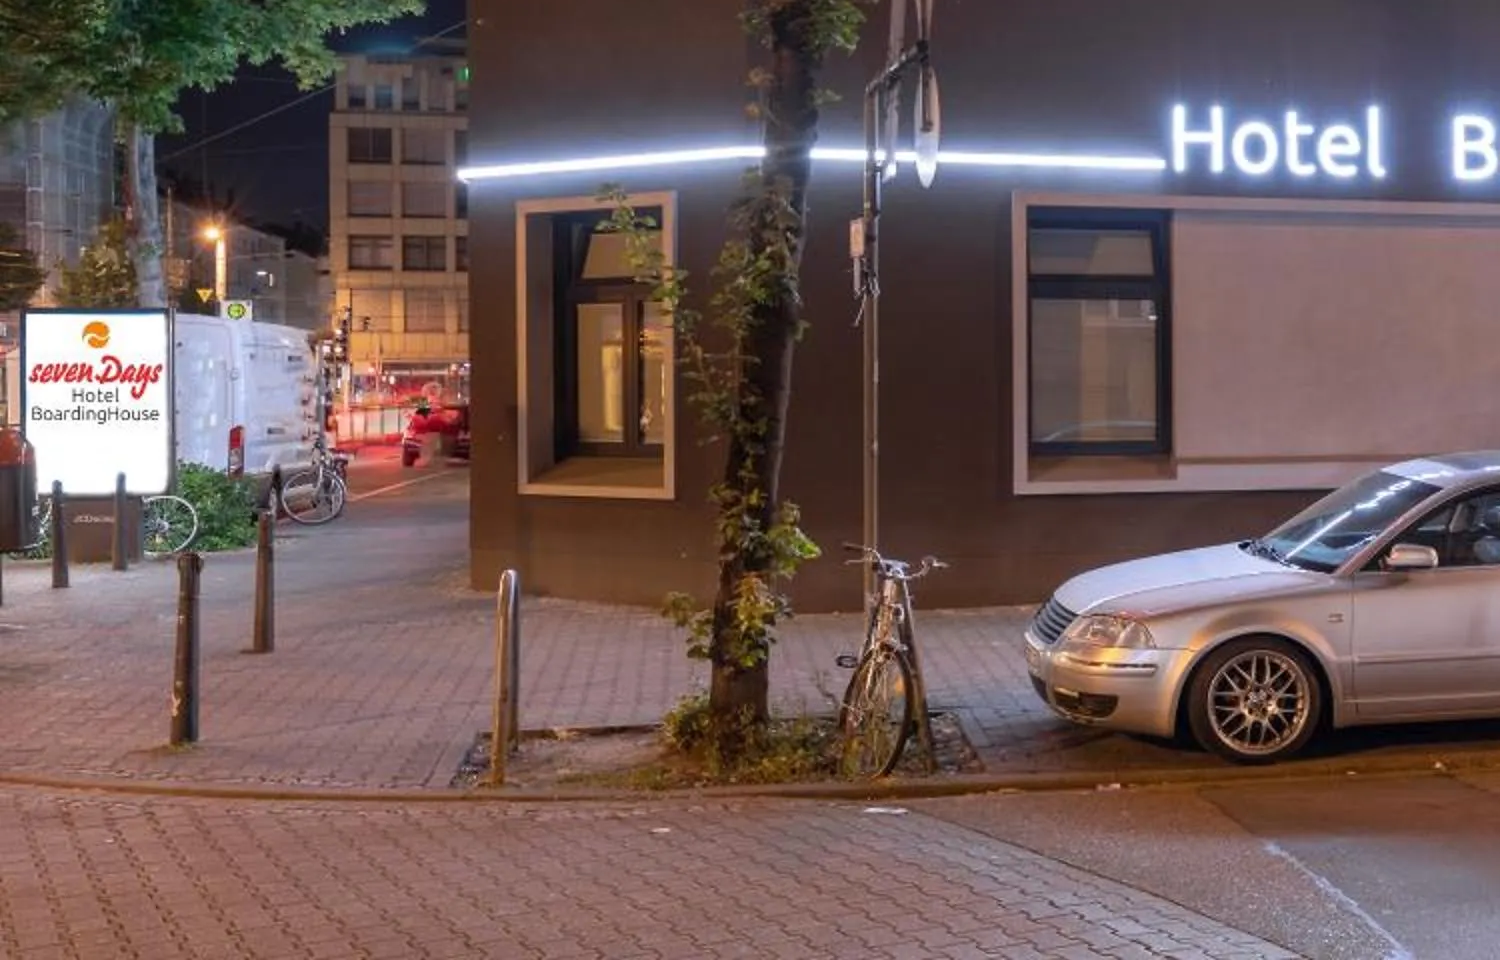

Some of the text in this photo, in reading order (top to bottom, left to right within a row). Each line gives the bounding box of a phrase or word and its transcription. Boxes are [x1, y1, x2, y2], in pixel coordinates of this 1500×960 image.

[1172, 103, 1387, 178] Hotel
[71, 387, 120, 403] Hotel
[31, 406, 160, 425] BoardingHouse
